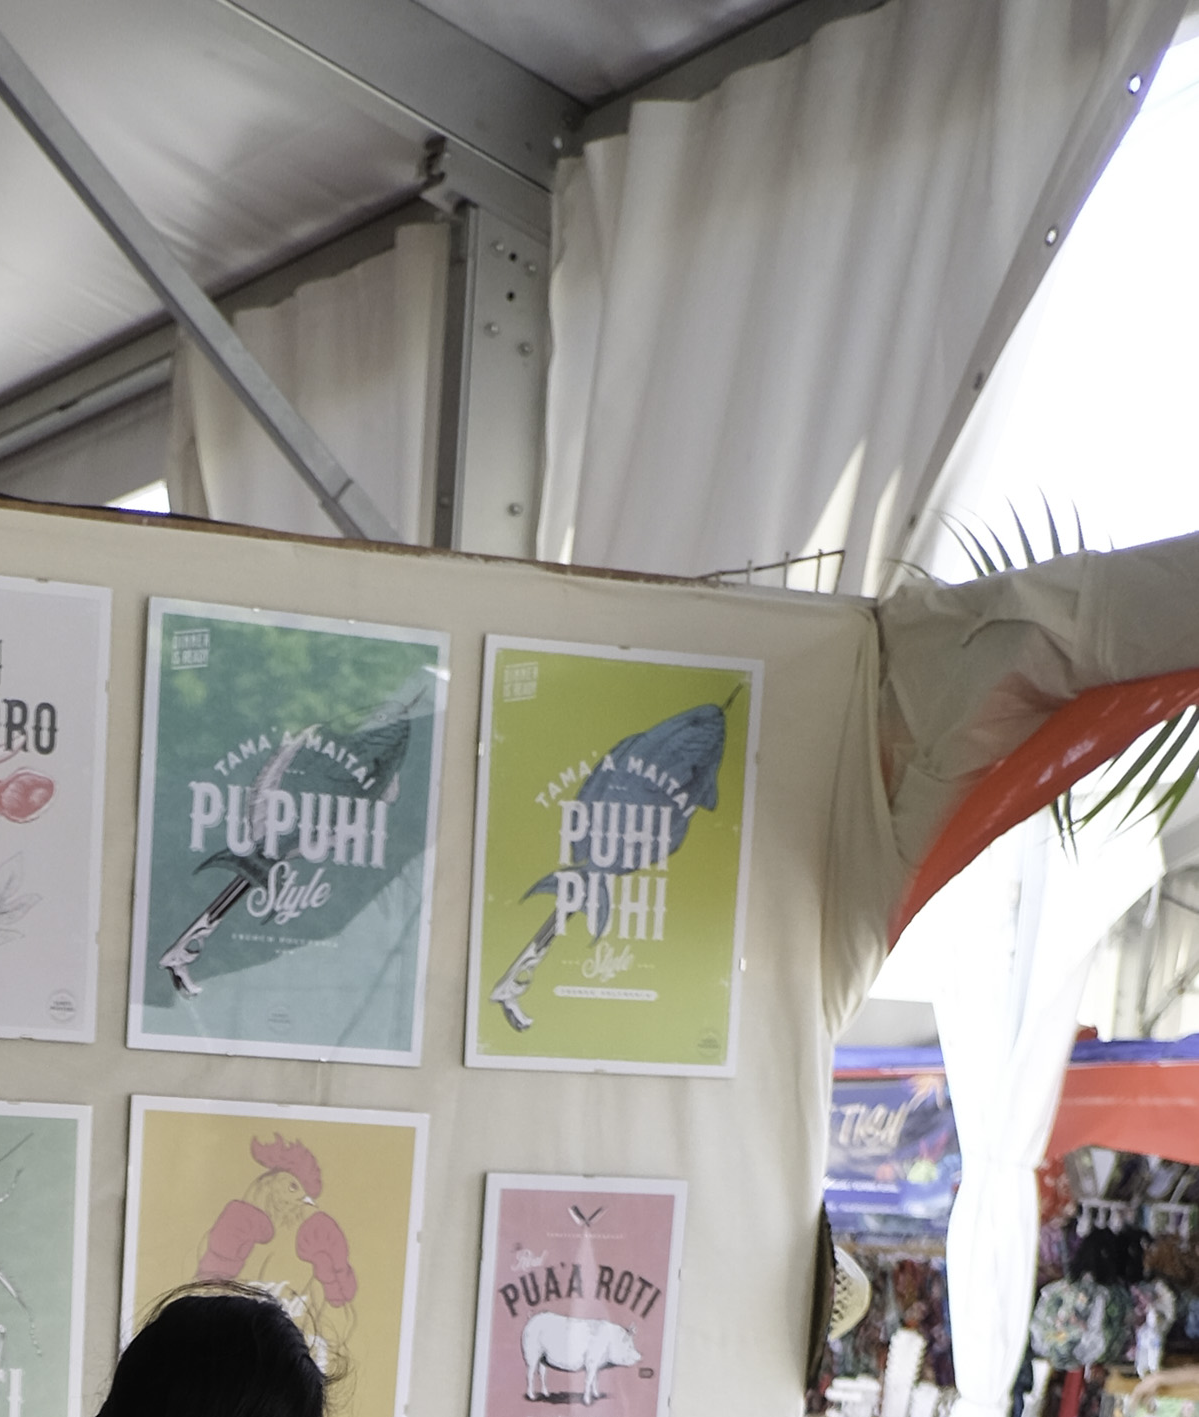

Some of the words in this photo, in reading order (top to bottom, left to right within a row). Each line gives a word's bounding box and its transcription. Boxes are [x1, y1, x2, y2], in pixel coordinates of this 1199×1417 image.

[626, 755, 698, 819] MAITAI
[190, 781, 389, 870] PUPUHI
[557, 799, 674, 872] PUHI
[247, 861, 332, 925] Style
[553, 871, 670, 942] PUHI
[498, 1262, 583, 1317] PUA'A
[595, 1264, 662, 1319] ROTI
